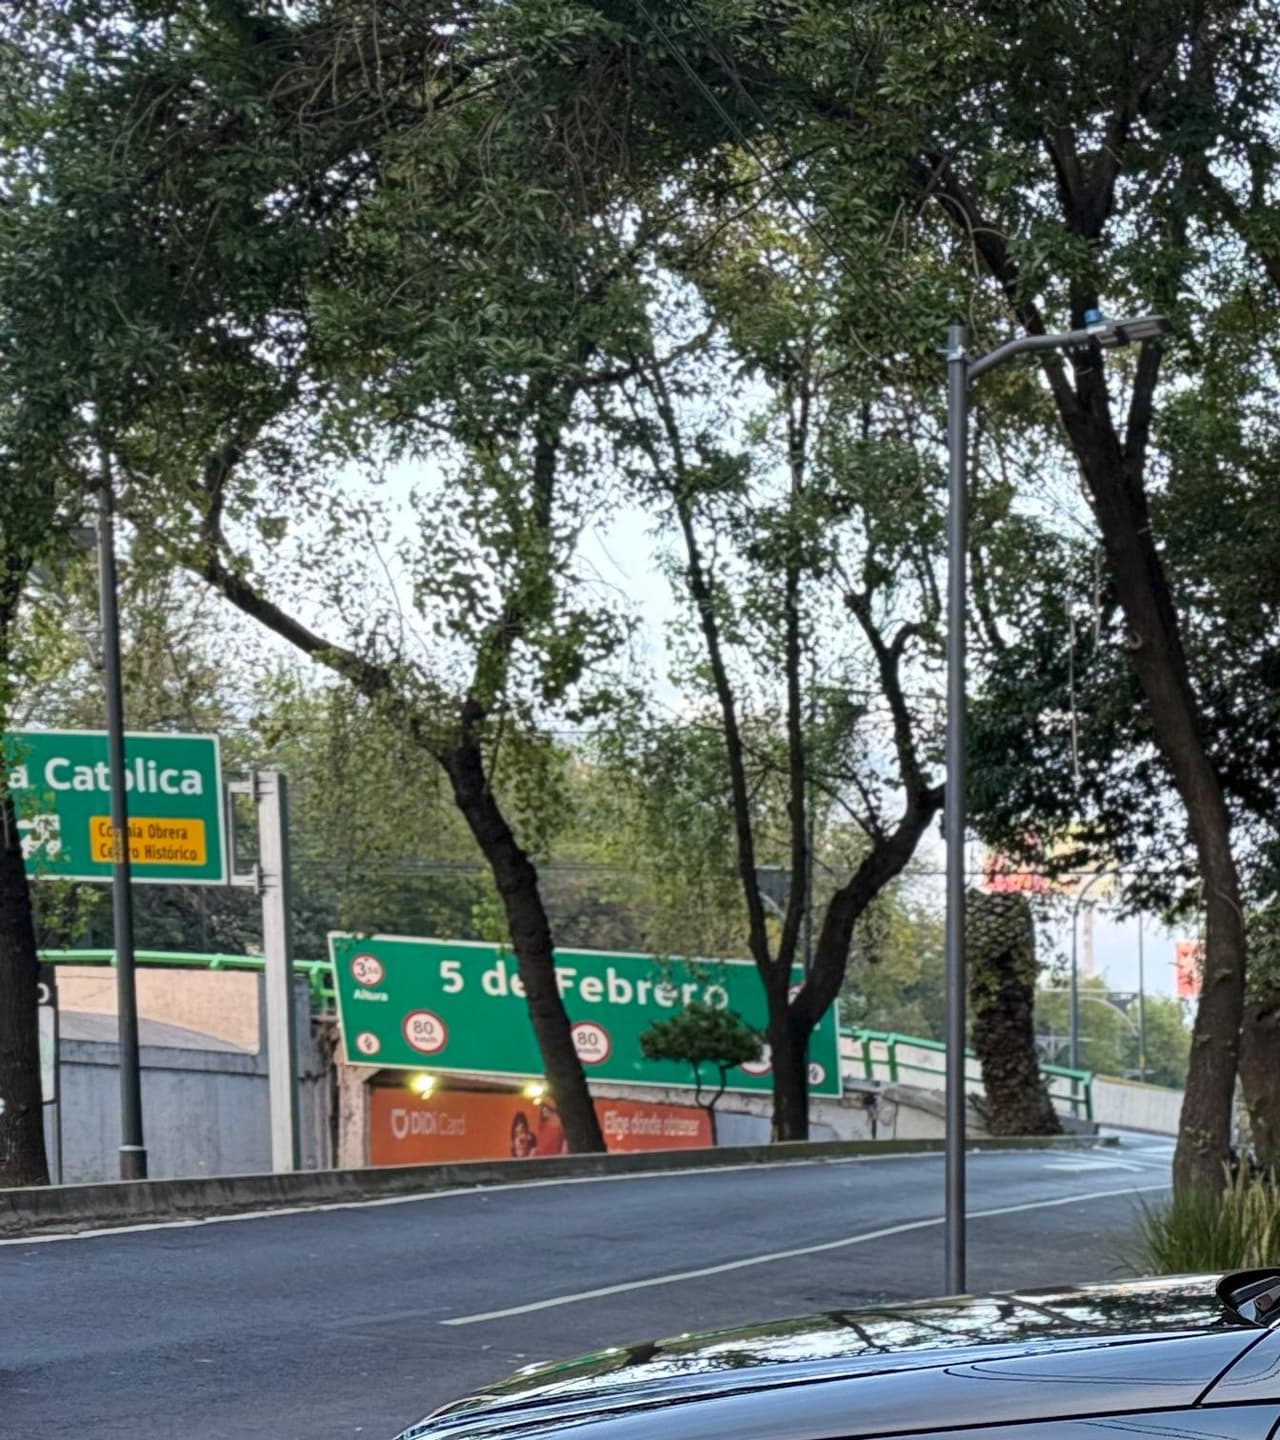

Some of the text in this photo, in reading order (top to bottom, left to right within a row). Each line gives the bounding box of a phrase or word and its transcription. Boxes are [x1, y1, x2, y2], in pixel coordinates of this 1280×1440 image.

[98, 822, 188, 840] Coia Obrera
[440, 960, 729, 1011] 5 de Febrero
[413, 1020, 435, 1035] 80
[577, 1031, 598, 1047] 80
